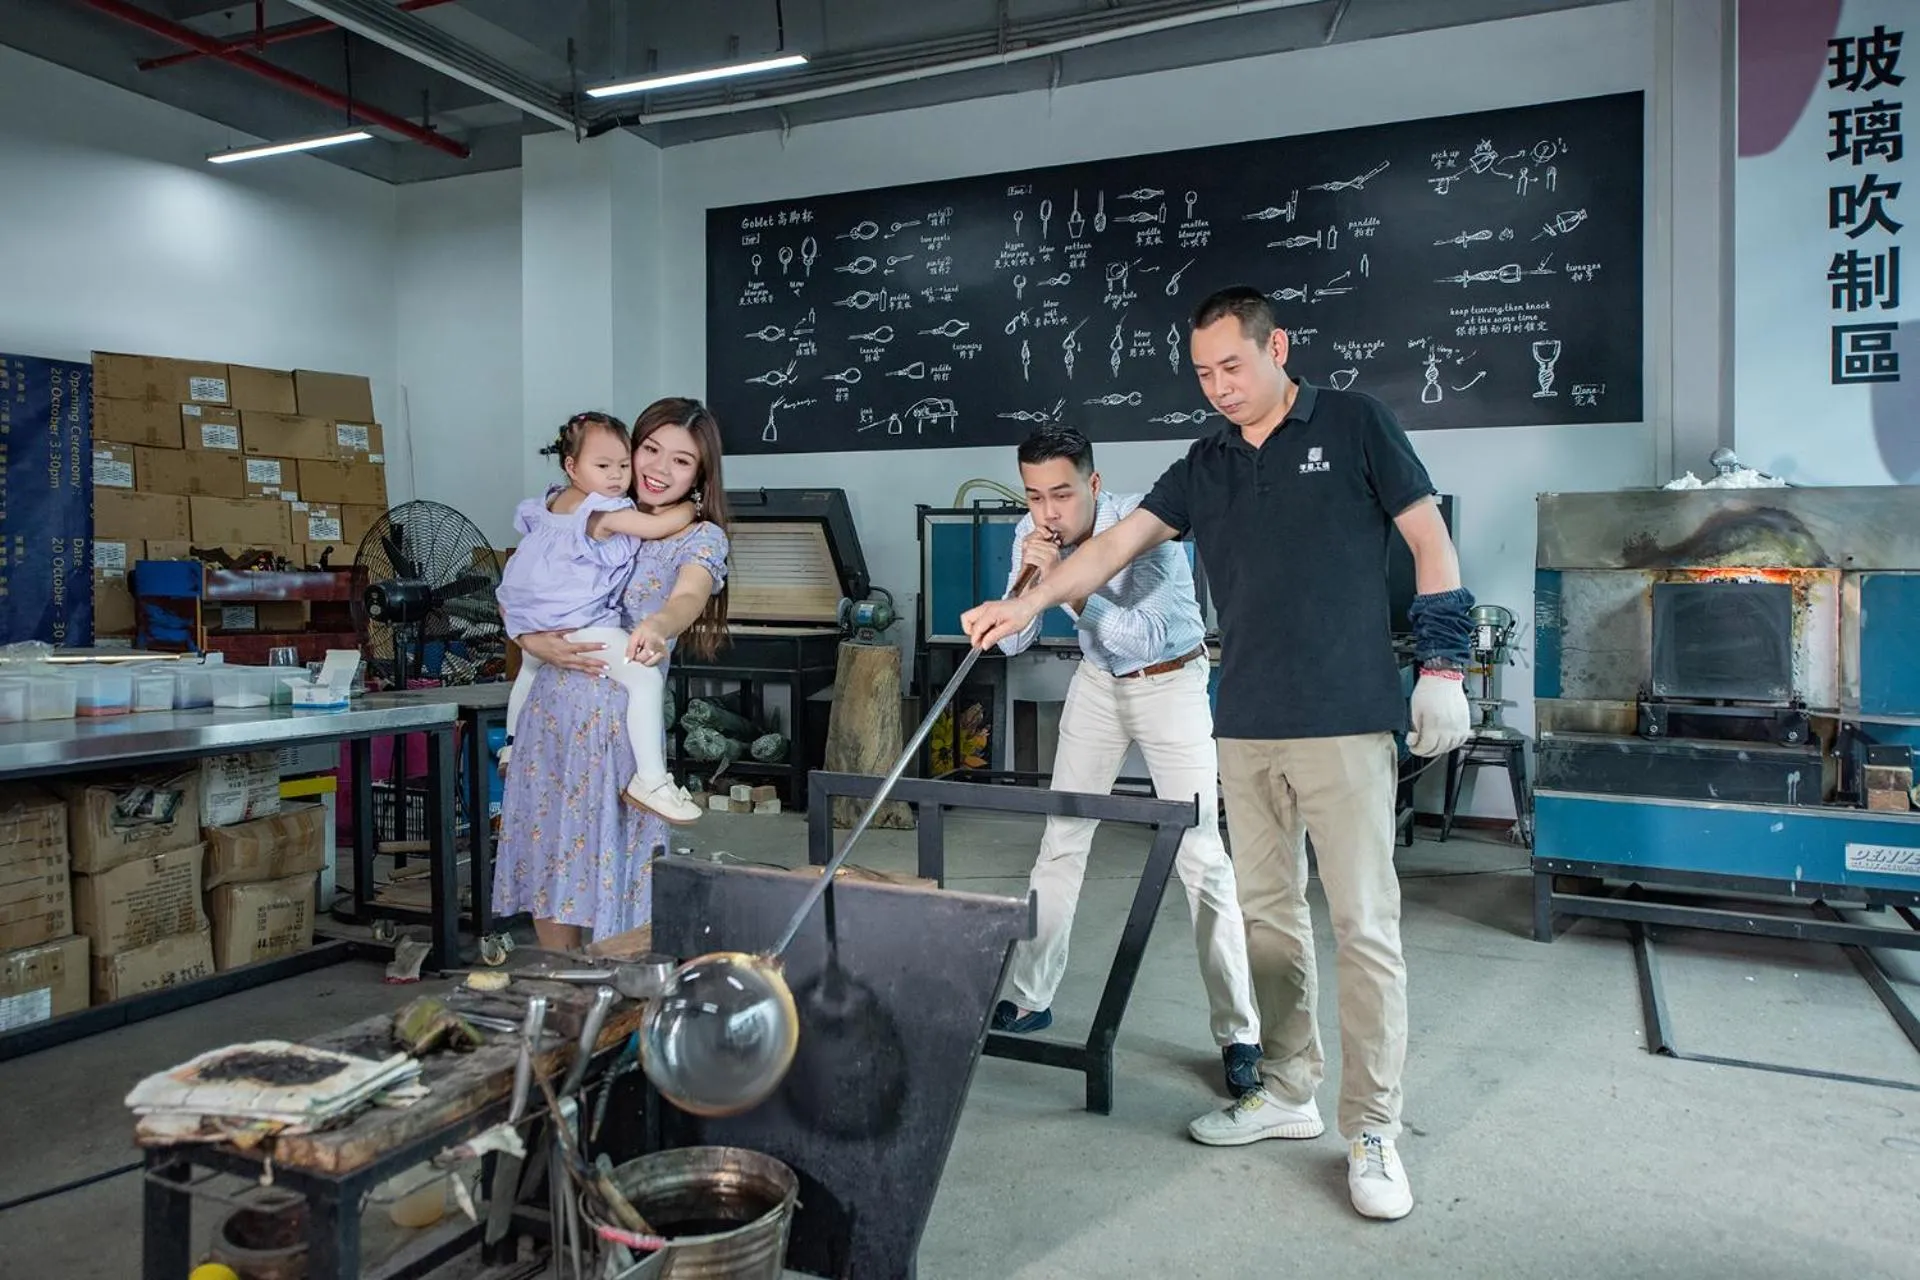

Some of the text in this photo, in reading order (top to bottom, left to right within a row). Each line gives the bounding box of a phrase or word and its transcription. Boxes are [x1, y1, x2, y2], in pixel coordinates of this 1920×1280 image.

[1827, 25, 1906, 385] 玻璃吹制區
[741, 215, 774, 229] Goblet
[51, 367, 62, 384] 20
[68, 370, 82, 422] Opening
[50, 387, 64, 437] October
[51, 537, 64, 553] 20
[73, 537, 84, 567] Date
[52, 557, 67, 607] October
[53, 621, 65, 638] 30
